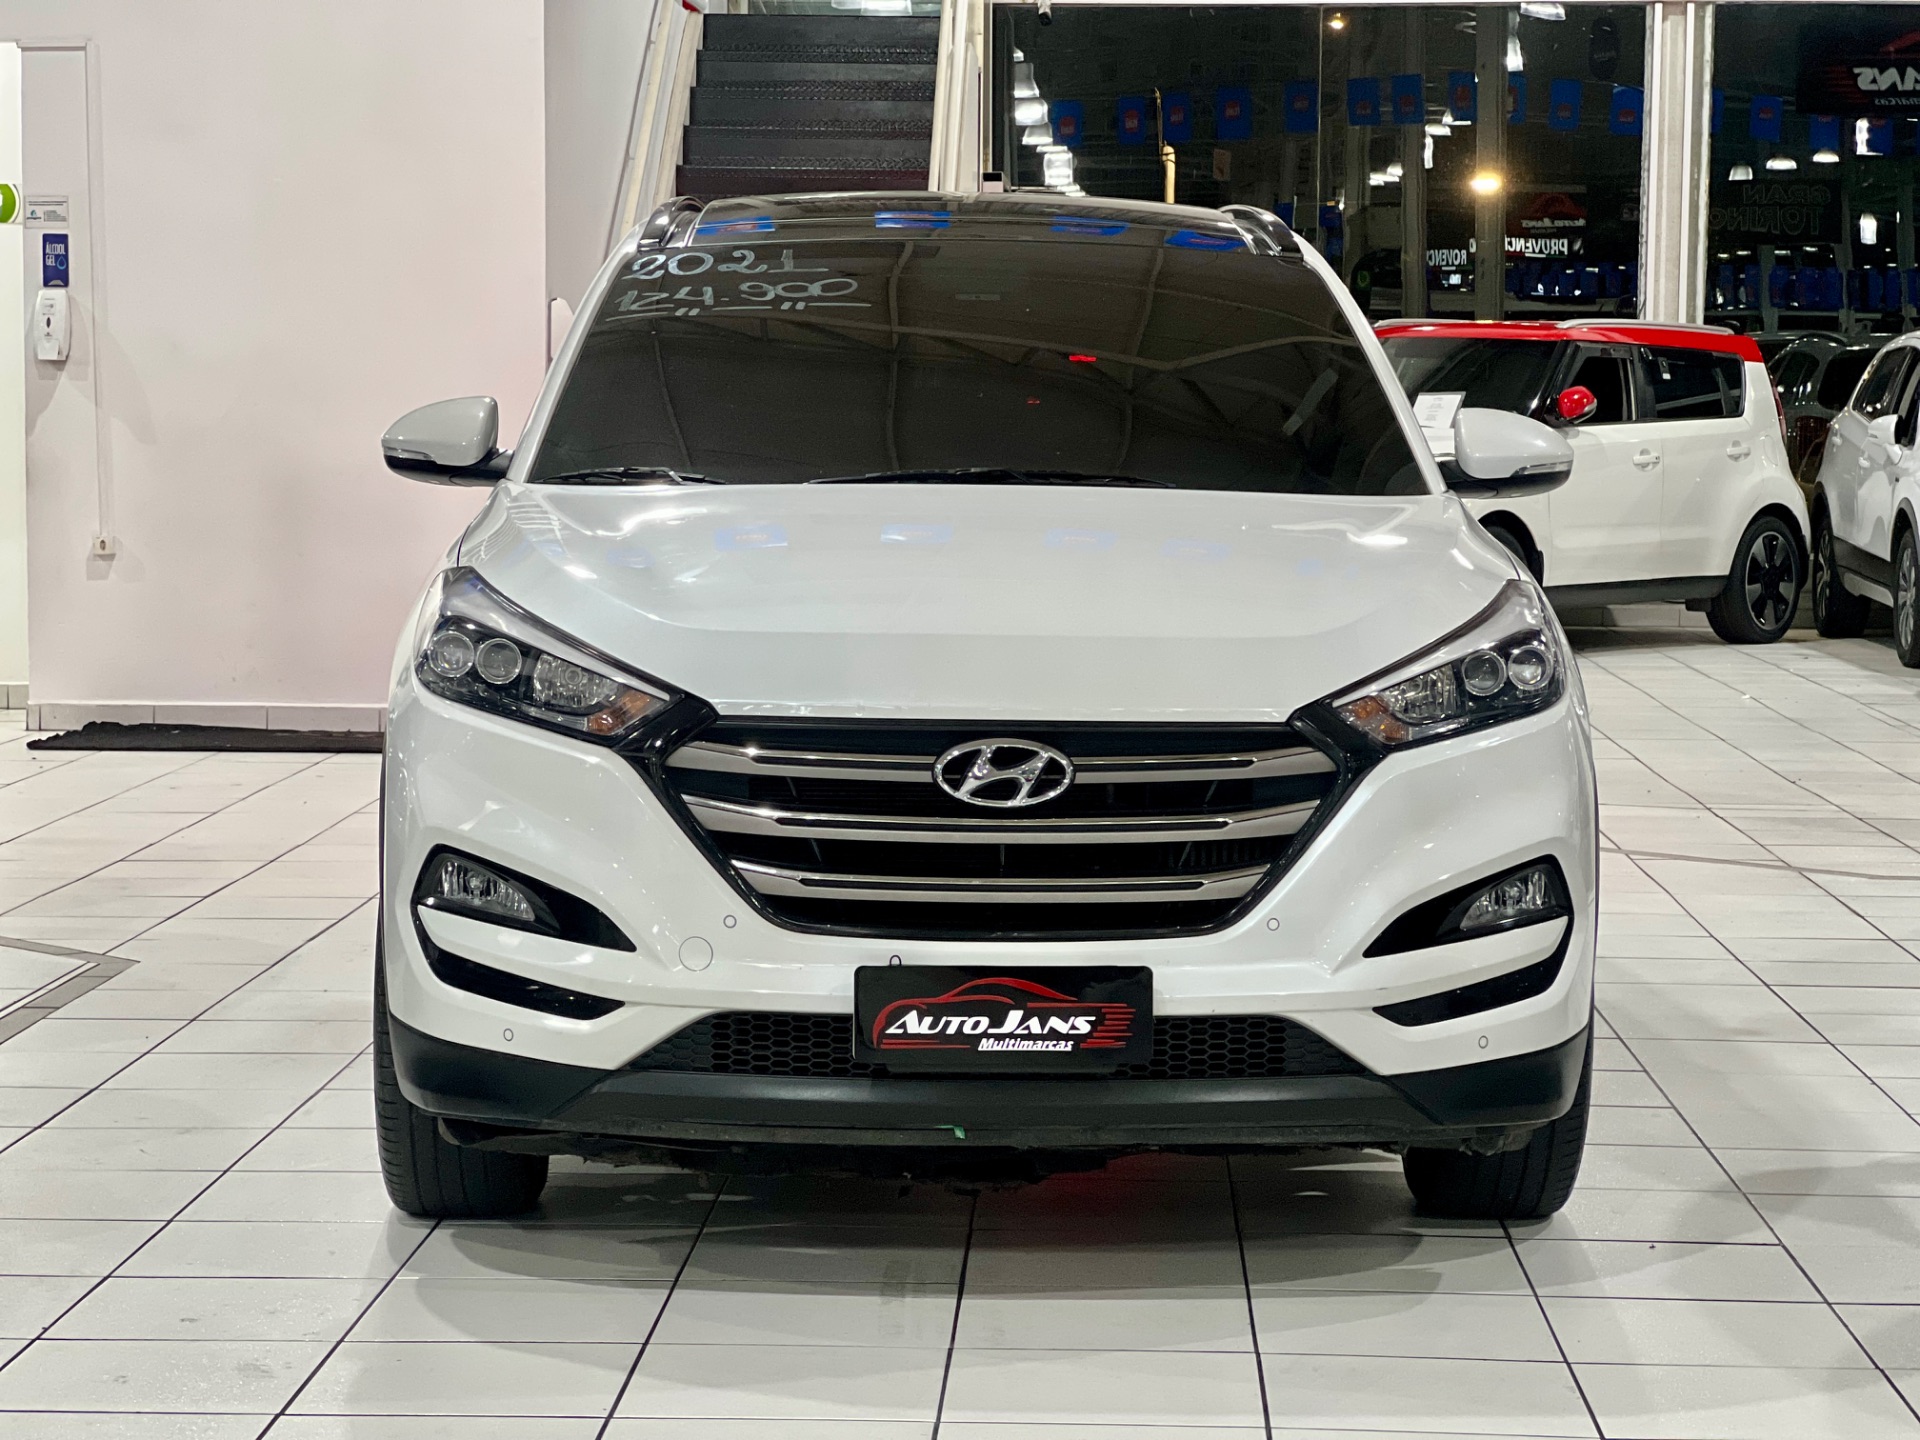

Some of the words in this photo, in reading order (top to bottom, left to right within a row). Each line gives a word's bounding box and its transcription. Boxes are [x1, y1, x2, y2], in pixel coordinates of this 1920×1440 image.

[45, 242, 66, 255] ÁLCOOL
[45, 255, 56, 266] GEL
[622, 249, 829, 280] 2021
[615, 278, 858, 312] 124.900
[885, 1009, 990, 1035] AUTO
[986, 1009, 1096, 1035] JANS
[977, 1037, 1074, 1051] Multimarcas
